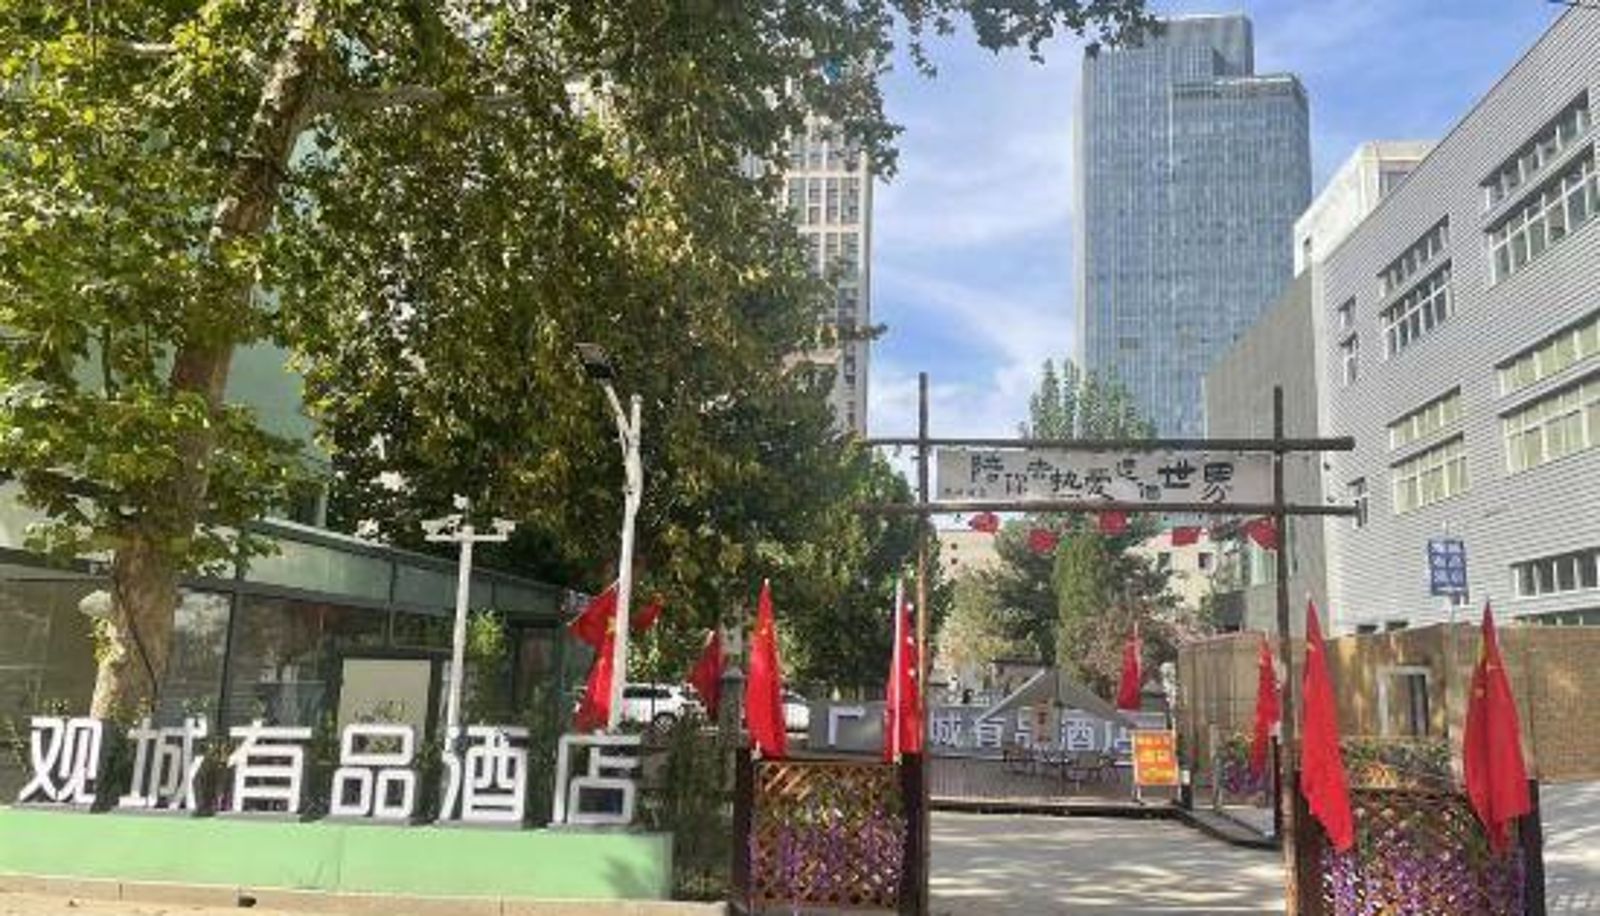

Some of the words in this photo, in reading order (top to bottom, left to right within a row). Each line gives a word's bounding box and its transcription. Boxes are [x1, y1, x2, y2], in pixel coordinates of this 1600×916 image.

[17, 716, 642, 827] 观城有品酒店
